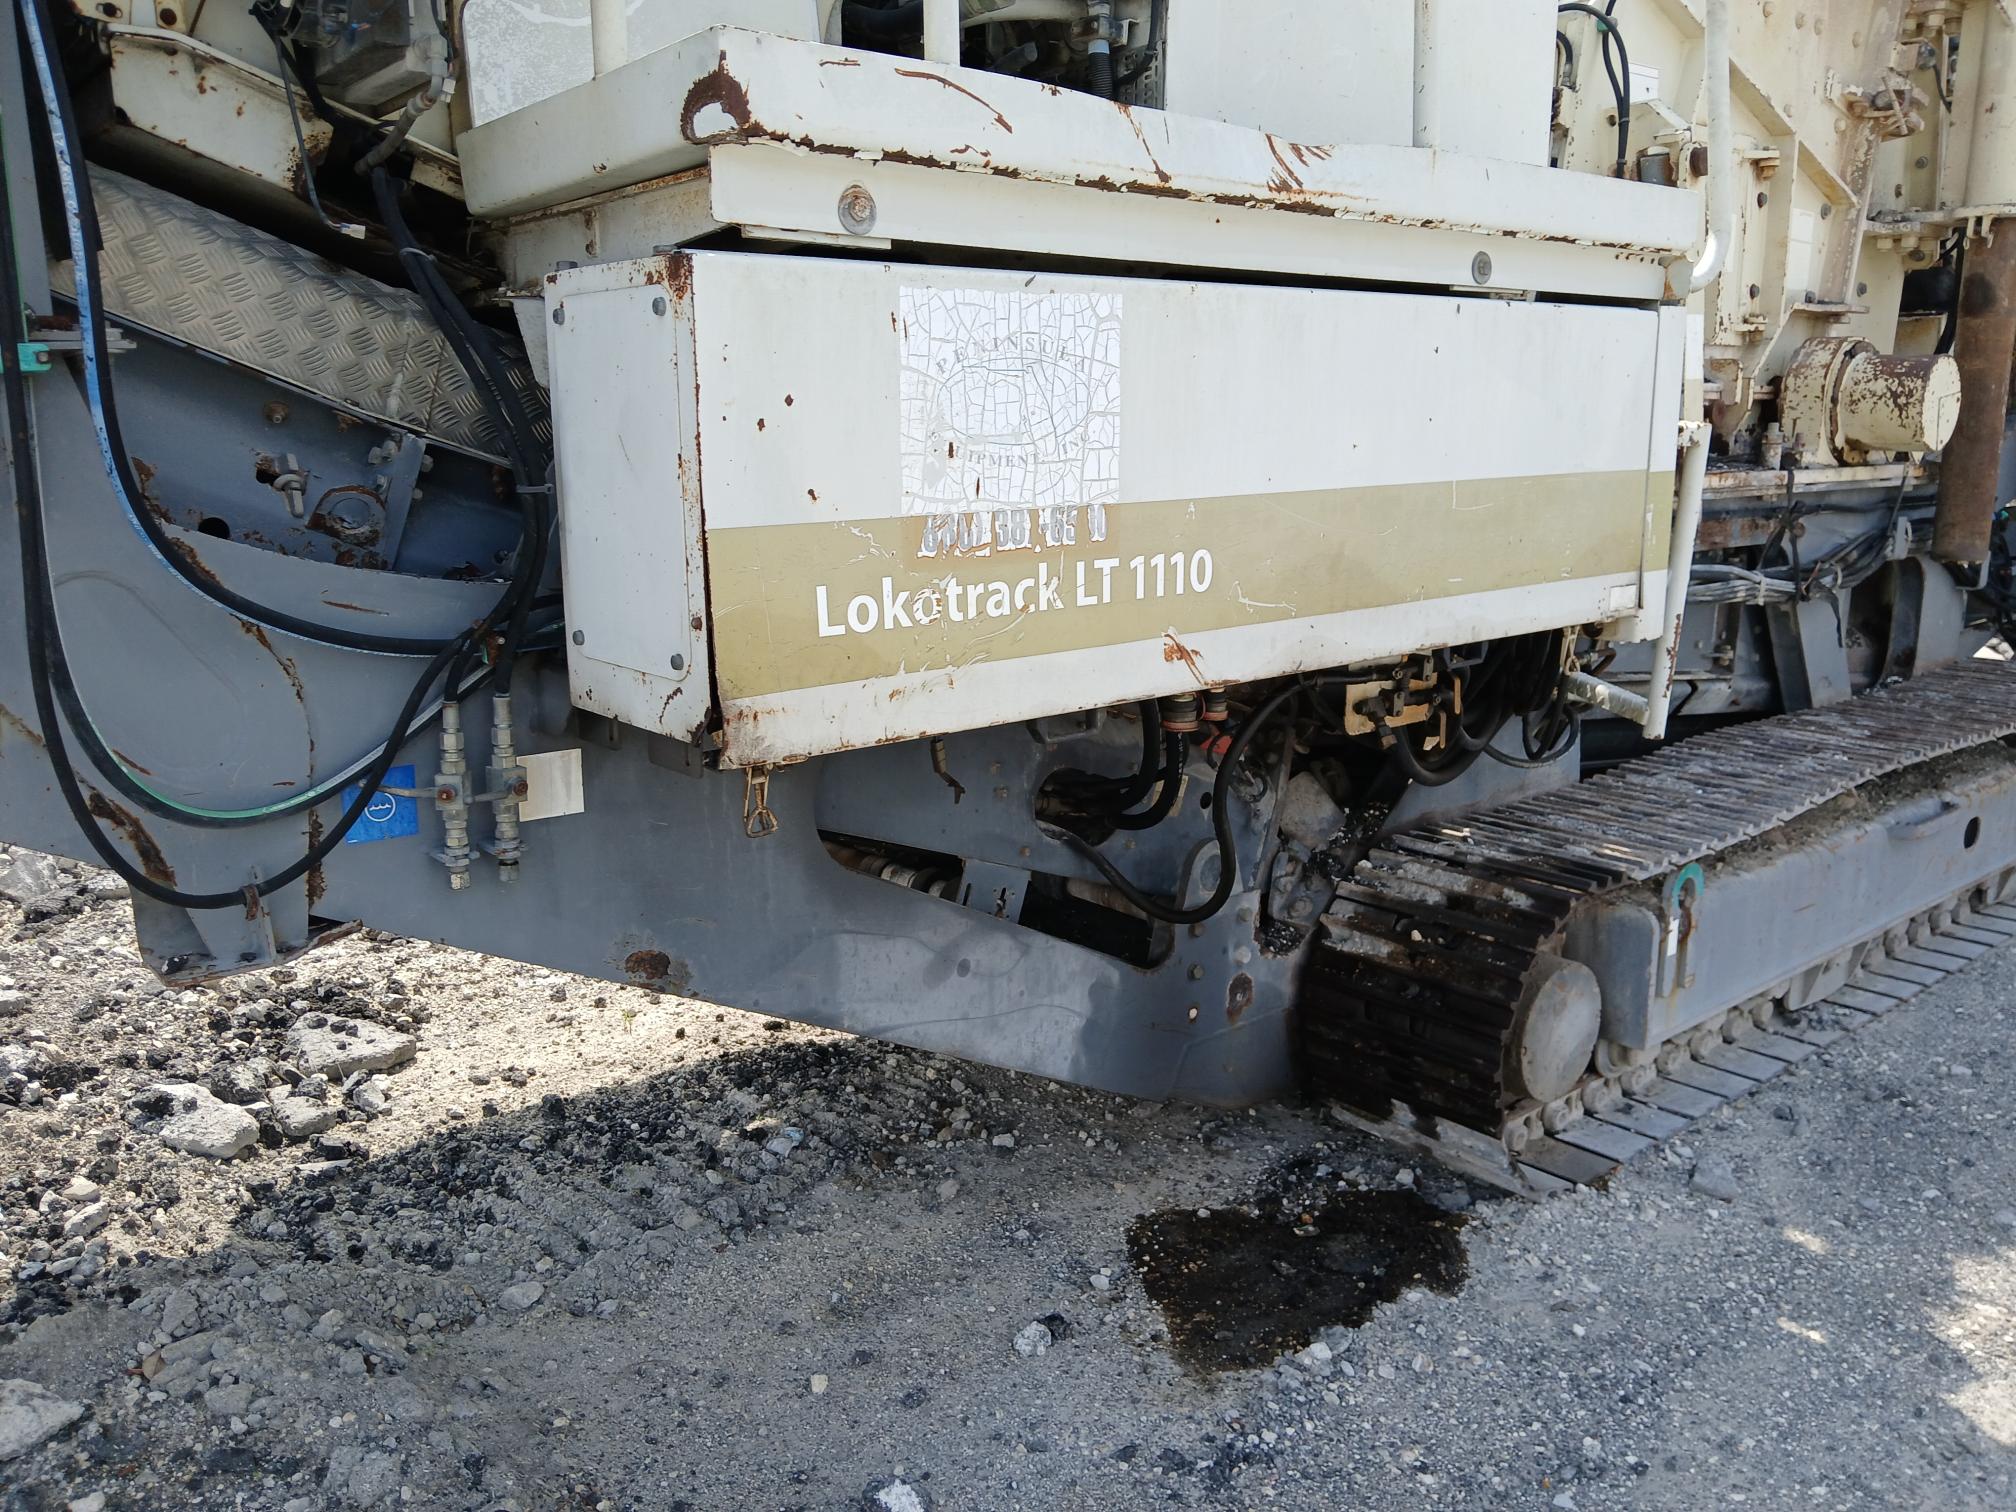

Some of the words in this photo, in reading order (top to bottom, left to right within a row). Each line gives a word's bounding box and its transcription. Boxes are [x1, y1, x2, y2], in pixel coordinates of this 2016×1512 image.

[936, 335, 1085, 374] PENINSULA
[931, 431, 1037, 468] UIPMENT
[816, 562, 1064, 637] Lokotrack
[1076, 557, 1120, 606] LT
[1129, 549, 1213, 600] 1110
